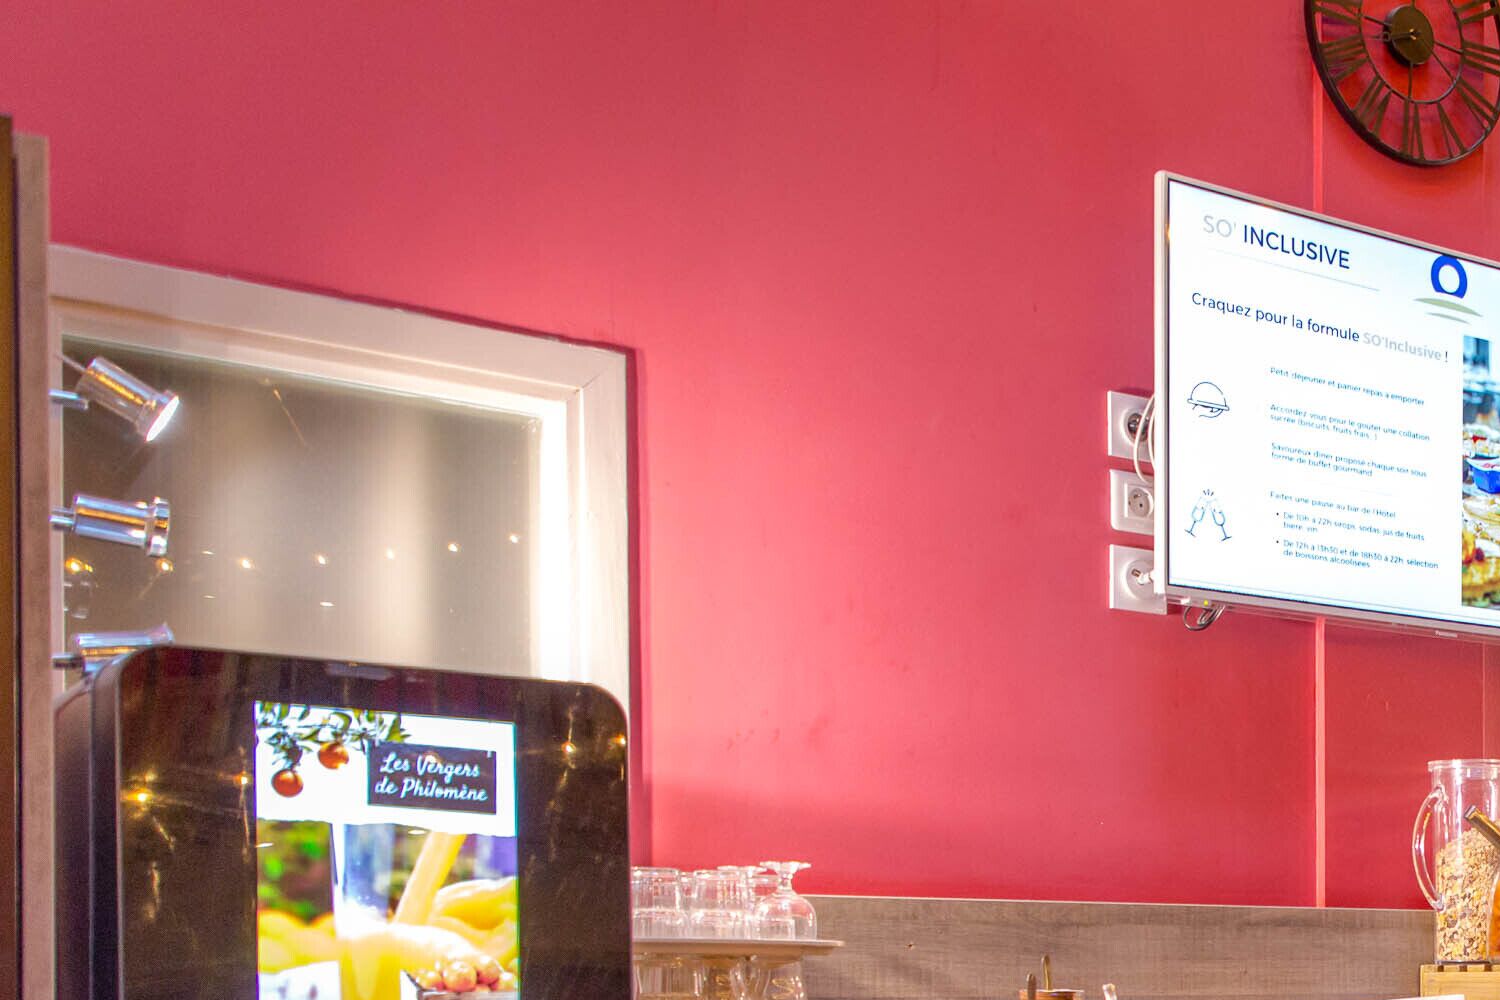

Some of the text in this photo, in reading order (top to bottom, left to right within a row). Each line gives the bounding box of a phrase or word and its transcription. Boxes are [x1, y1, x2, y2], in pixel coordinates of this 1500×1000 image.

[1203, 215, 1350, 270] SO' INCLUSIVE
[1191, 292, 1251, 318] Craquez
[1255, 308, 1288, 327] pour
[1292, 314, 1303, 329] la
[1307, 318, 1360, 342] formule
[1327, 380, 1336, 388] et
[1337, 382, 1361, 393] panier
[1363, 387, 1383, 398] repas
[1391, 393, 1425, 406] emporter
[1383, 426, 1397, 435] une
[1399, 427, 1430, 441] collation
[1296, 456, 1306, 465] de
[1333, 464, 1373, 478] gourmand
[1295, 496, 1309, 505] une
[1361, 506, 1371, 515] de
[1283, 511, 1294, 520] De
[1395, 529, 1405, 538] de
[1283, 539, 1294, 548] De
[1340, 547, 1347, 556] et
[1349, 549, 1359, 558] de
[1283, 548, 1293, 558] de
[379, 752, 411, 774] Les
[374, 775, 488, 802] de Philomène
